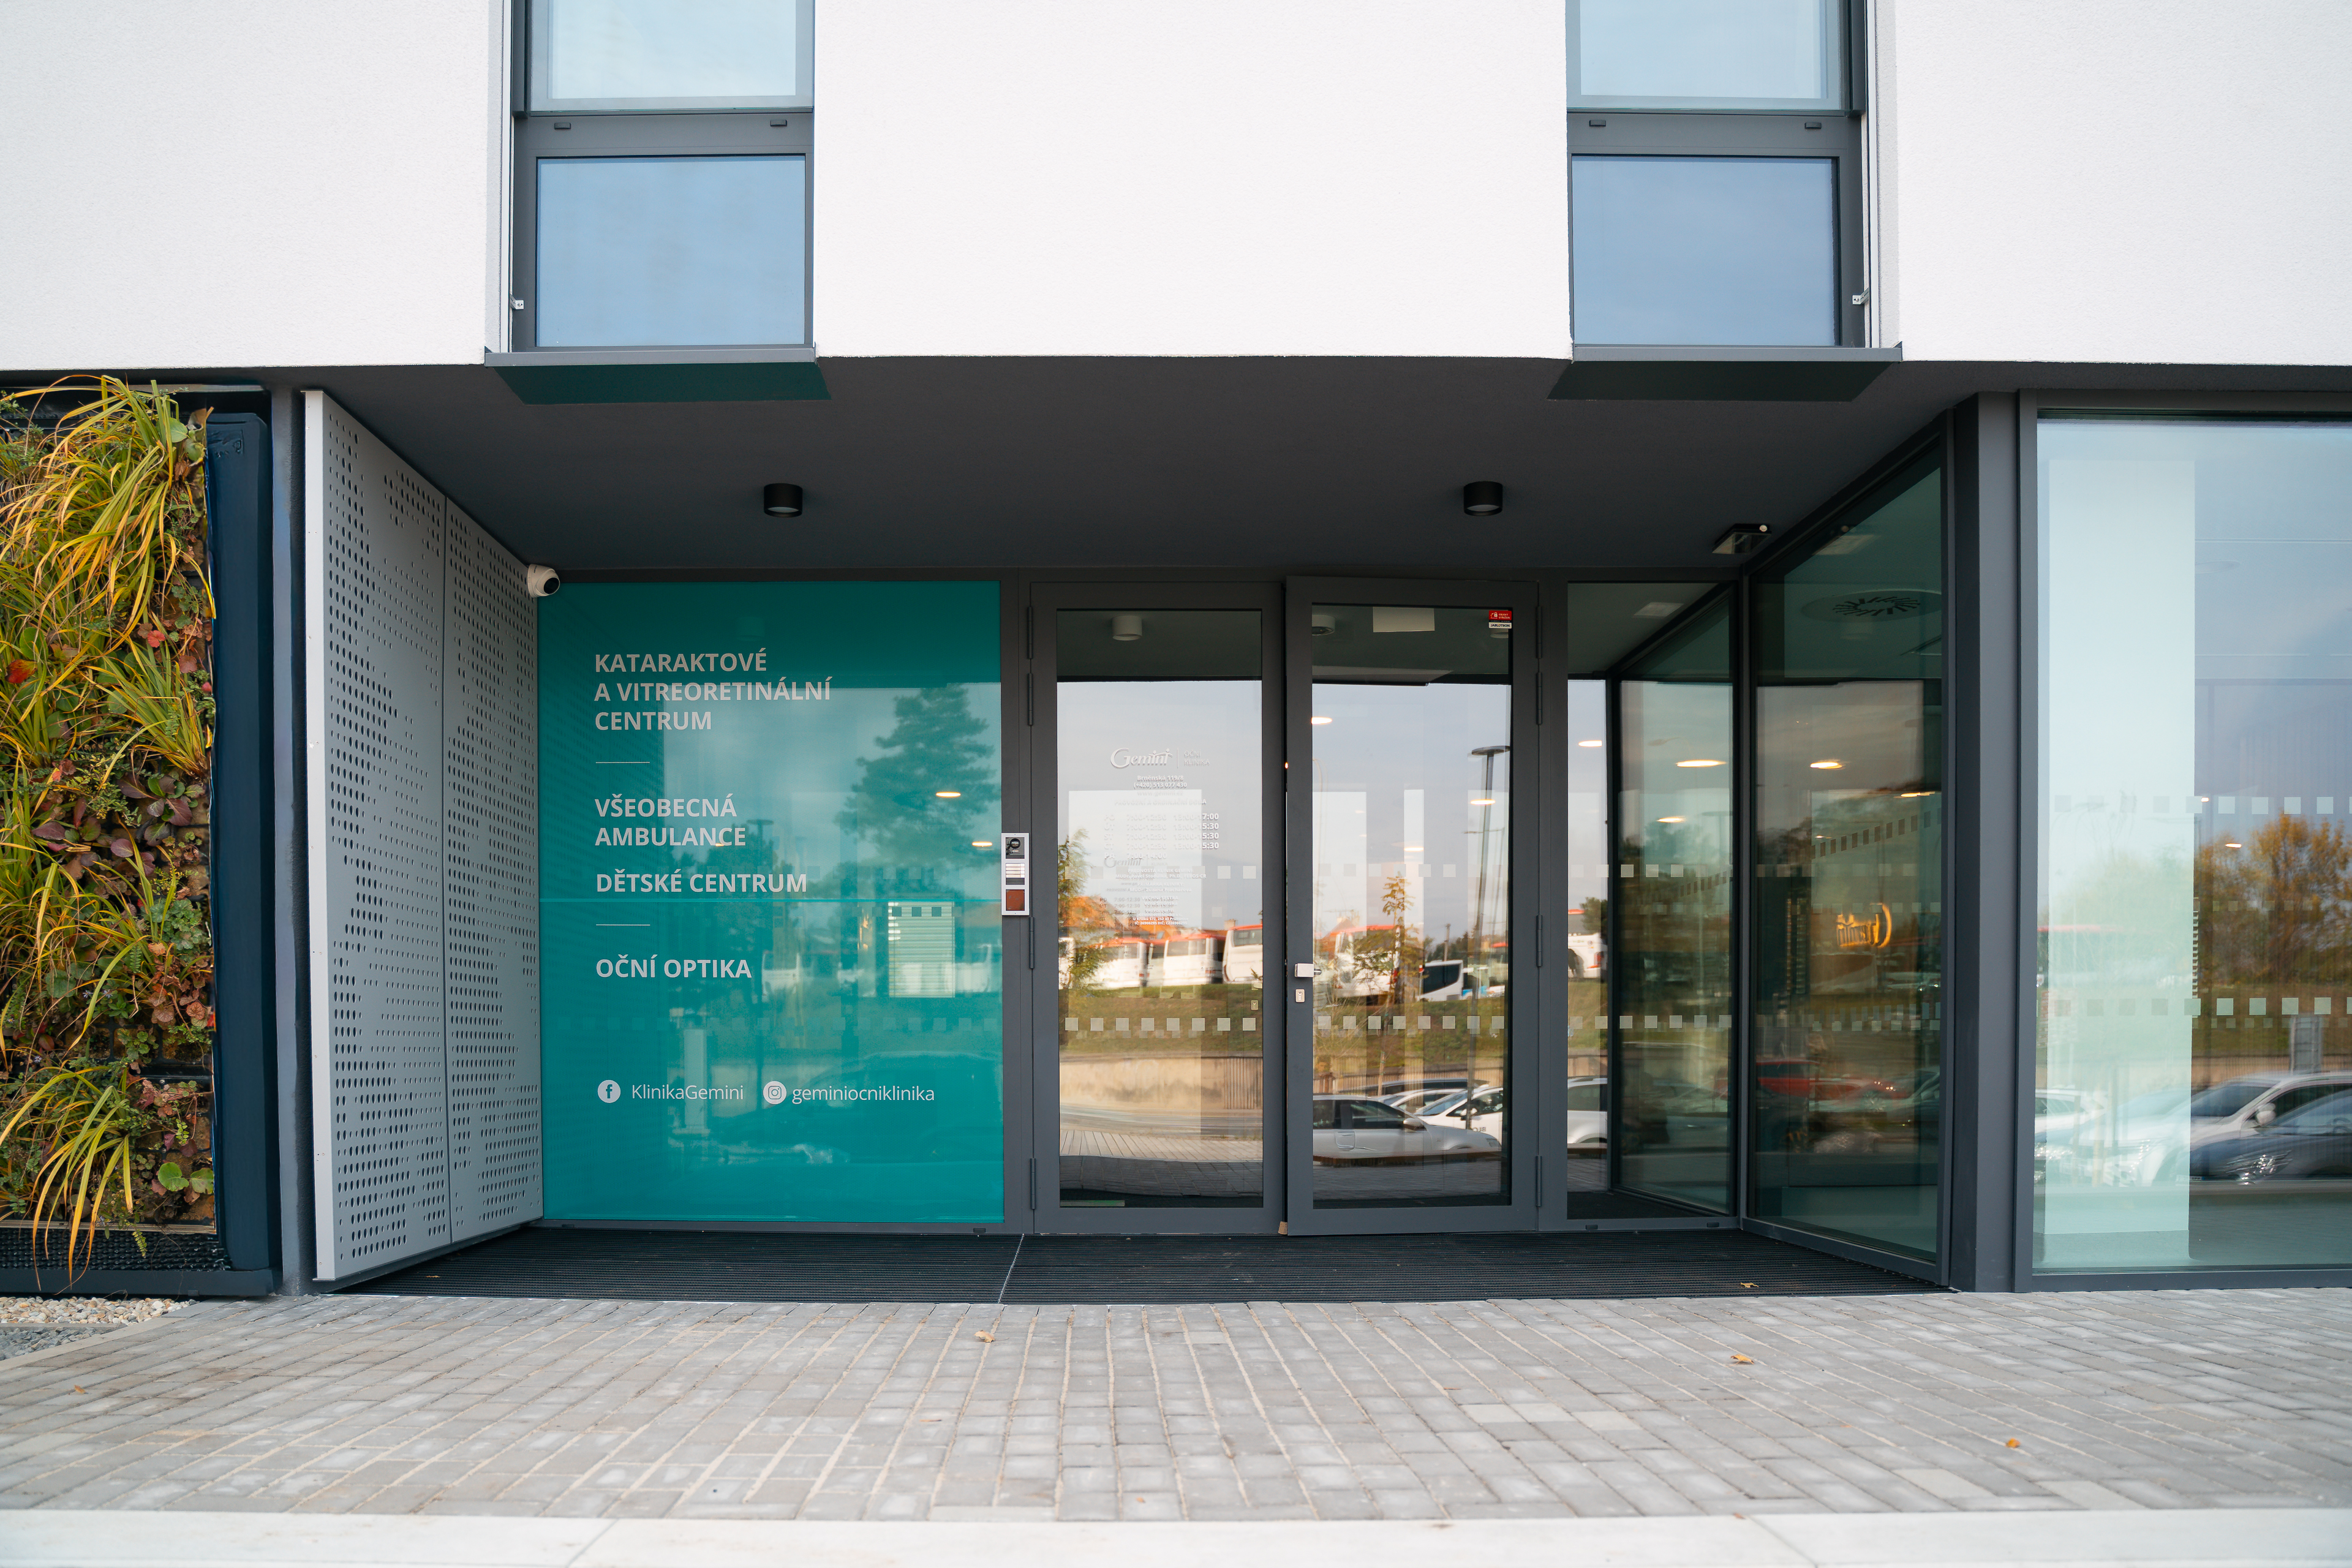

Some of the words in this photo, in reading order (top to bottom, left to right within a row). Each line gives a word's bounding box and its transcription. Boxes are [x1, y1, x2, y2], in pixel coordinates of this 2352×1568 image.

[595, 647, 767, 673] KATARAKTOVÉ
[594, 683, 611, 701] A
[617, 676, 833, 701] VITREORETINÁLNÍ
[595, 711, 711, 731] CENTRUM
[1110, 747, 1173, 769] Gemini
[595, 793, 737, 817] VŠEOBECNÁ
[595, 826, 746, 846] AMBULANCE
[597, 869, 682, 892] DĚTSKÉ
[689, 873, 807, 892] CENTRUM
[596, 954, 658, 978] OČNÍ
[663, 959, 752, 978] OPTIKA
[632, 1084, 744, 1099] KlinikaGemini
[792, 1084, 935, 1105] geminiocniklinika
